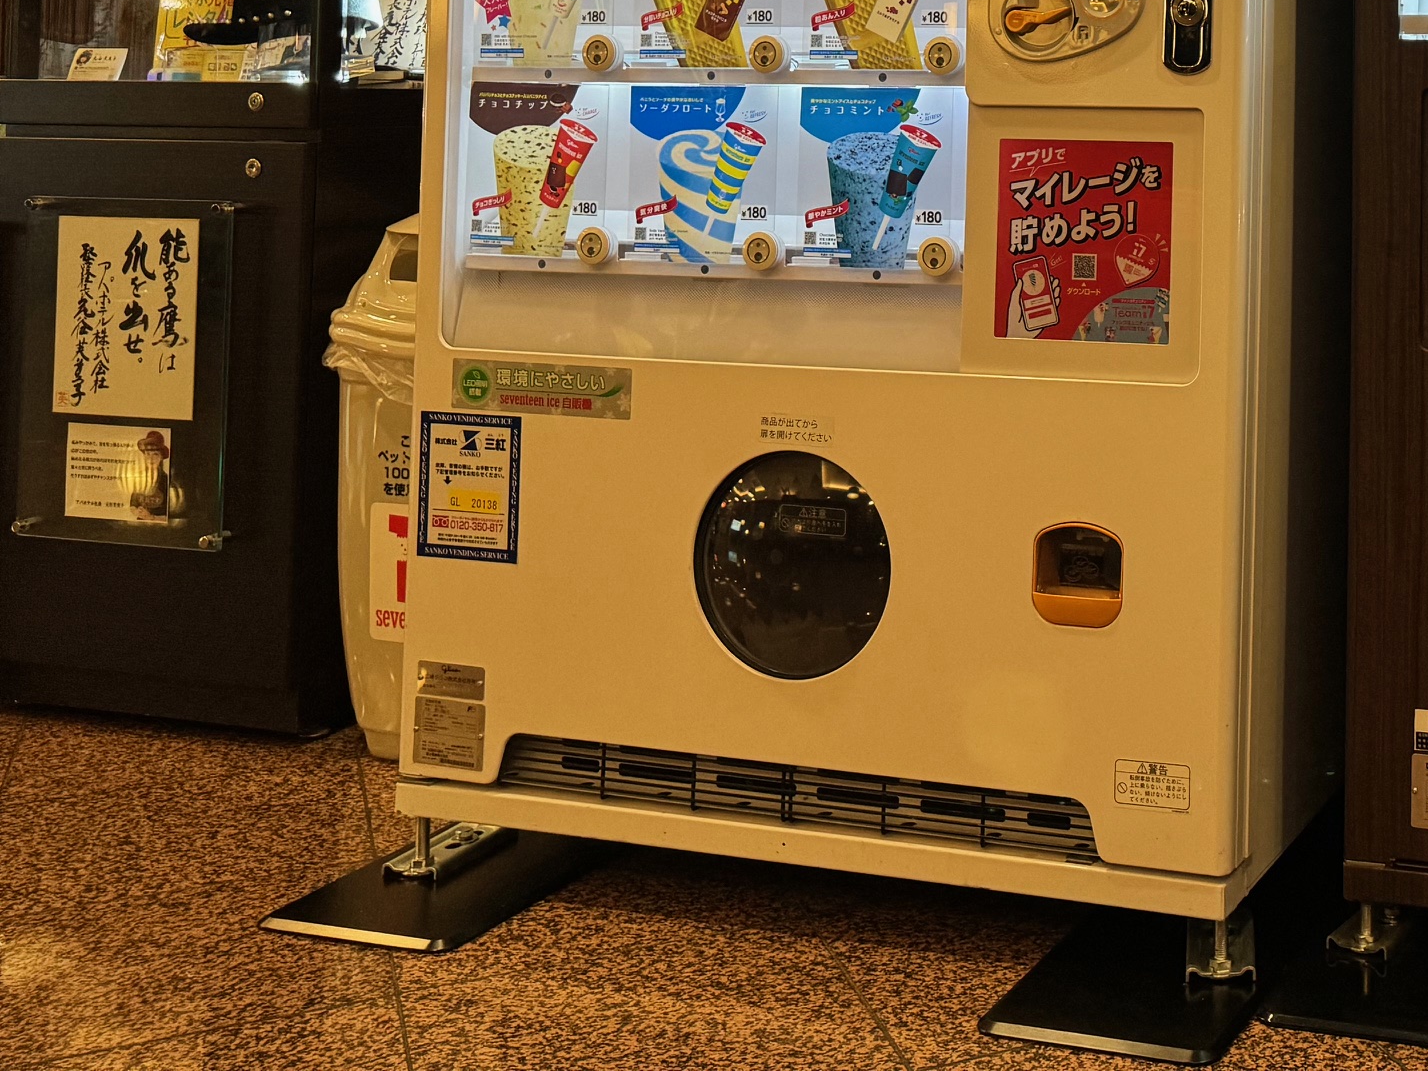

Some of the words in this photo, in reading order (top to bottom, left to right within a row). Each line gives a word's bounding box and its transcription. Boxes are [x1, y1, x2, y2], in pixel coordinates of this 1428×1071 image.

[478, 99, 548, 110] チョコチップ
[640, 103, 711, 114] ソーダフロート
[810, 105, 884, 115] チョコミント
[1011, 147, 1066, 168] アプリで
[1010, 157, 1162, 210] マイレージを
[1009, 201, 1139, 255] 貯めよう!
[1067, 287, 1101, 296] ダウンロード
[496, 368, 605, 390] 環境にやさしい
[500, 393, 545, 406] seventeen
[547, 394, 560, 408] ice
[562, 397, 592, 410] 自販機
[429, 413, 451, 421] SANKO
[453, 415, 483, 424] VENDING
[484, 416, 513, 425] SERVICE
[760, 416, 819, 429] 商品が出てから
[760, 429, 832, 443] 扉を開けてください
[484, 437, 506, 452] 三紅
[450, 497, 460, 507] GL
[450, 519, 503, 533] 0120-350-817
[425, 546, 448, 555] SANKO
[449, 548, 479, 558] VENDING
[480, 551, 509, 560] SERVICE
[1148, 763, 1169, 776] 警告
